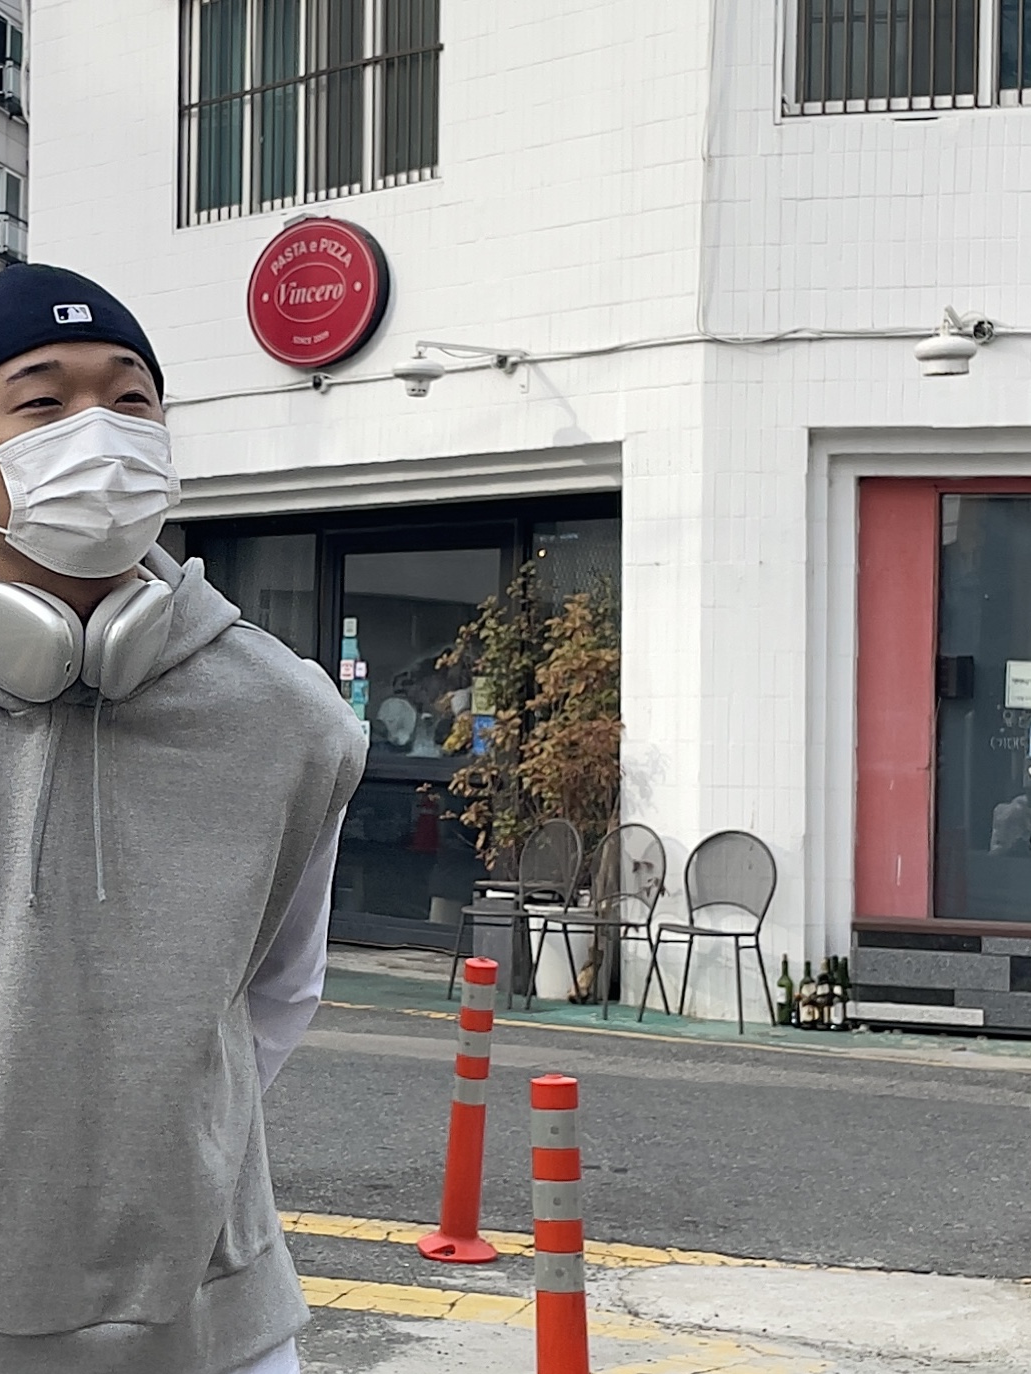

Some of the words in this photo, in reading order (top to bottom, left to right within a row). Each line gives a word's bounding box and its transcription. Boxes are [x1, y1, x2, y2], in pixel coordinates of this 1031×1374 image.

[270, 240, 307, 276] PASTA
[309, 241, 318, 253] e
[319, 238, 353, 269] PIZZA
[279, 282, 344, 306] Vincero
